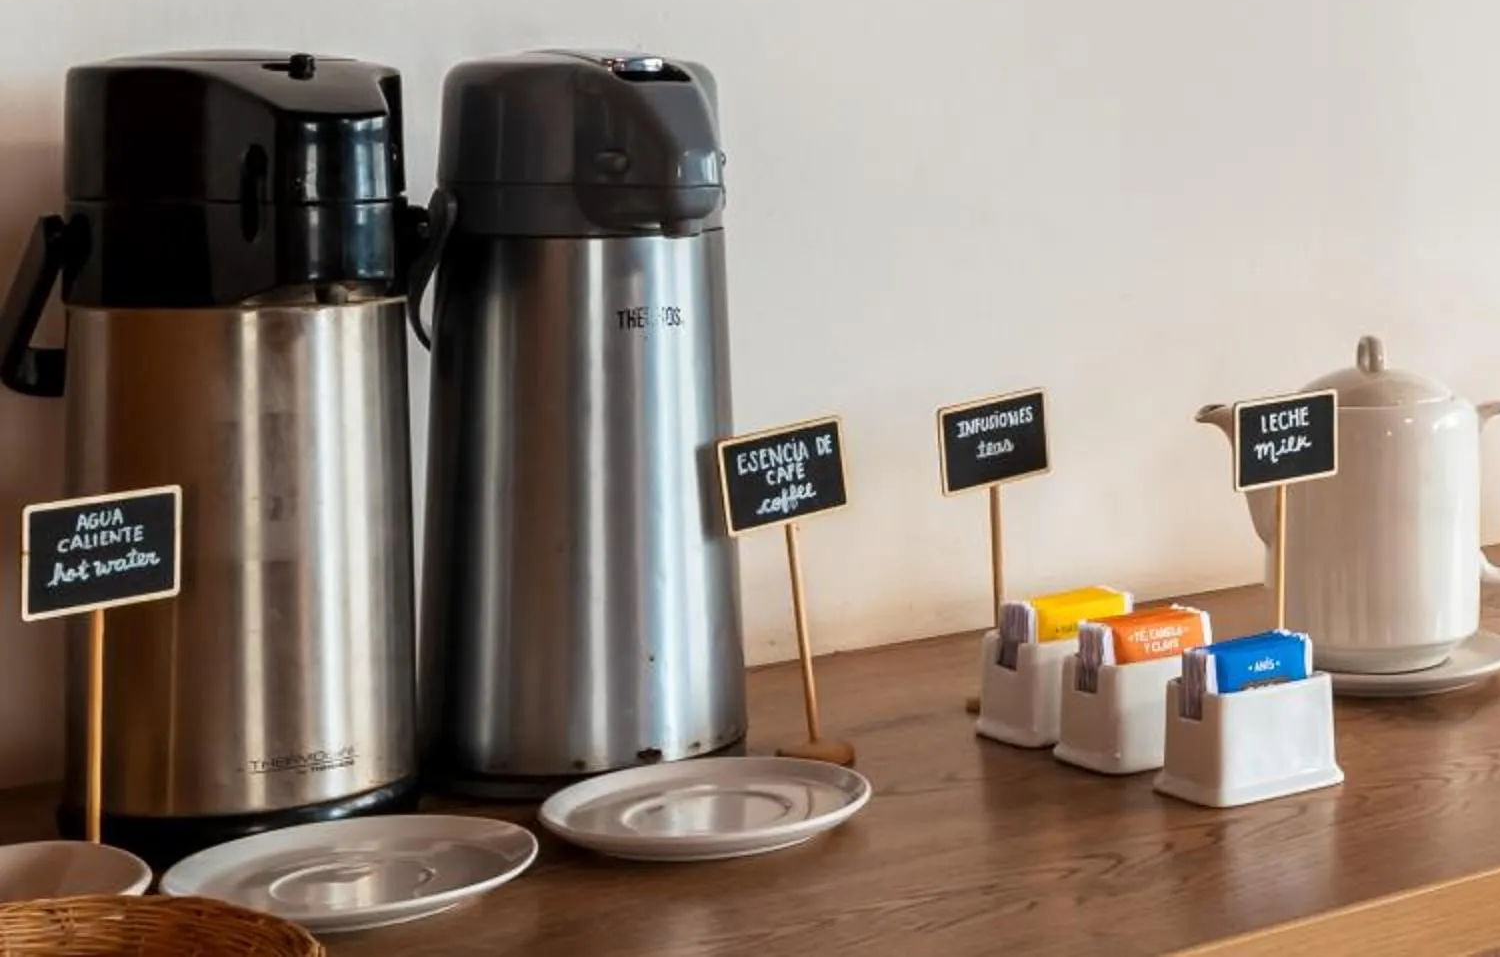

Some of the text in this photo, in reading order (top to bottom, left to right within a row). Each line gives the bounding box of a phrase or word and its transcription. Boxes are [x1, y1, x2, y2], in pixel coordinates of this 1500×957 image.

[617, 307, 682, 330] THEOS
[1261, 406, 1309, 433] LECHE
[815, 434, 833, 456] DE
[756, 482, 817, 514] coffee
[76, 508, 124, 532] AGUA
[57, 525, 144, 554] CALIENTE
[47, 547, 160, 588] hot water
